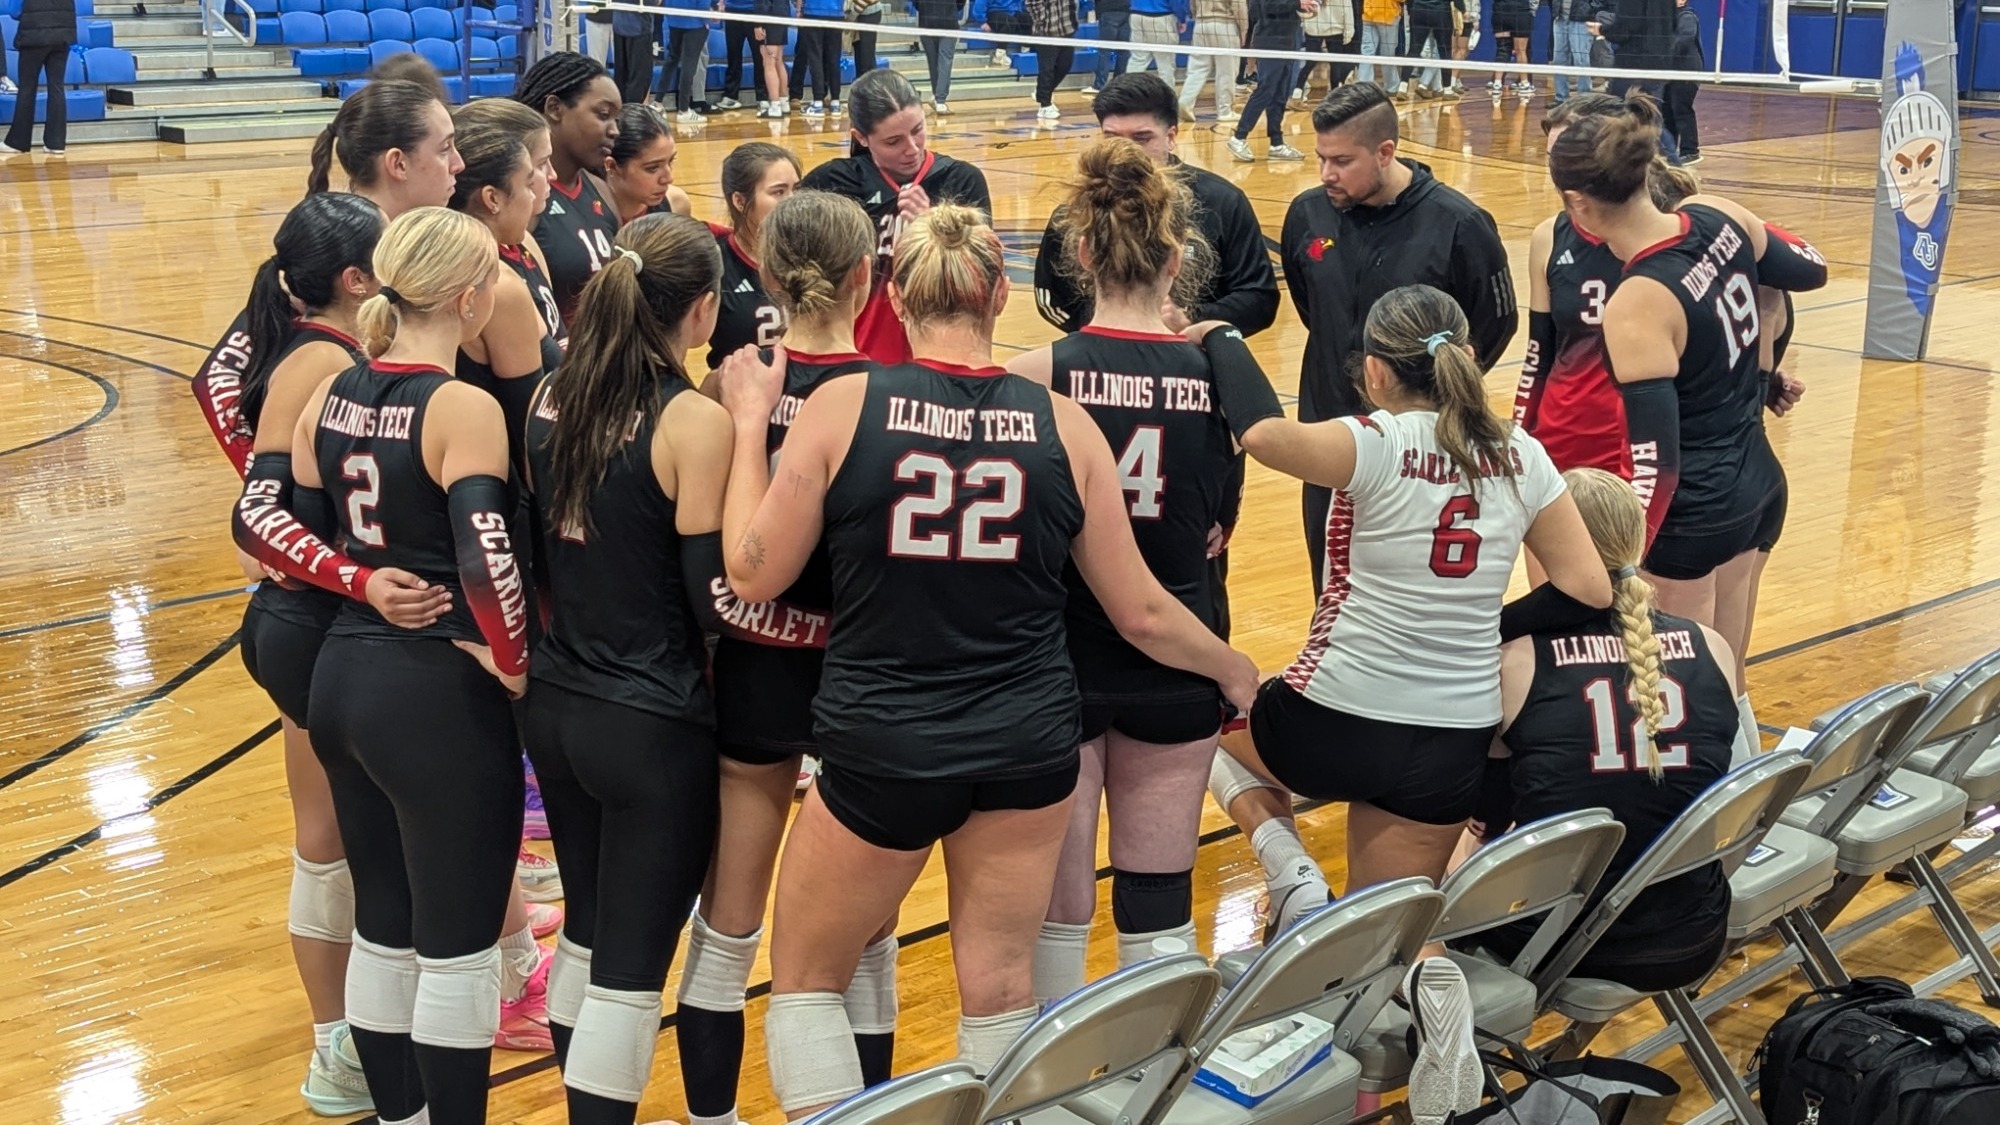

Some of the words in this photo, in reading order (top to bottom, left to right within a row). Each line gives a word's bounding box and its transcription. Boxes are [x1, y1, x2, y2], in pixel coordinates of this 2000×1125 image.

[1708, 222, 1743, 266] TECH
[1715, 272, 1760, 371] 19
[886, 396, 976, 442] ILLINOIS
[979, 409, 1038, 443] TECH
[1069, 369, 1154, 409] ILLINOIS
[1161, 376, 1213, 413] TECH
[342, 452, 386, 549] 2
[888, 449, 1027, 562] 22
[1116, 423, 1168, 521] 4
[1400, 447, 1461, 485] SCARLE
[239, 478, 337, 575] SCARLET
[1428, 493, 1484, 579] 6
[1551, 634, 1629, 668] ILLINO
[1656, 630, 1697, 661] ECH
[1583, 676, 1691, 773] 12
